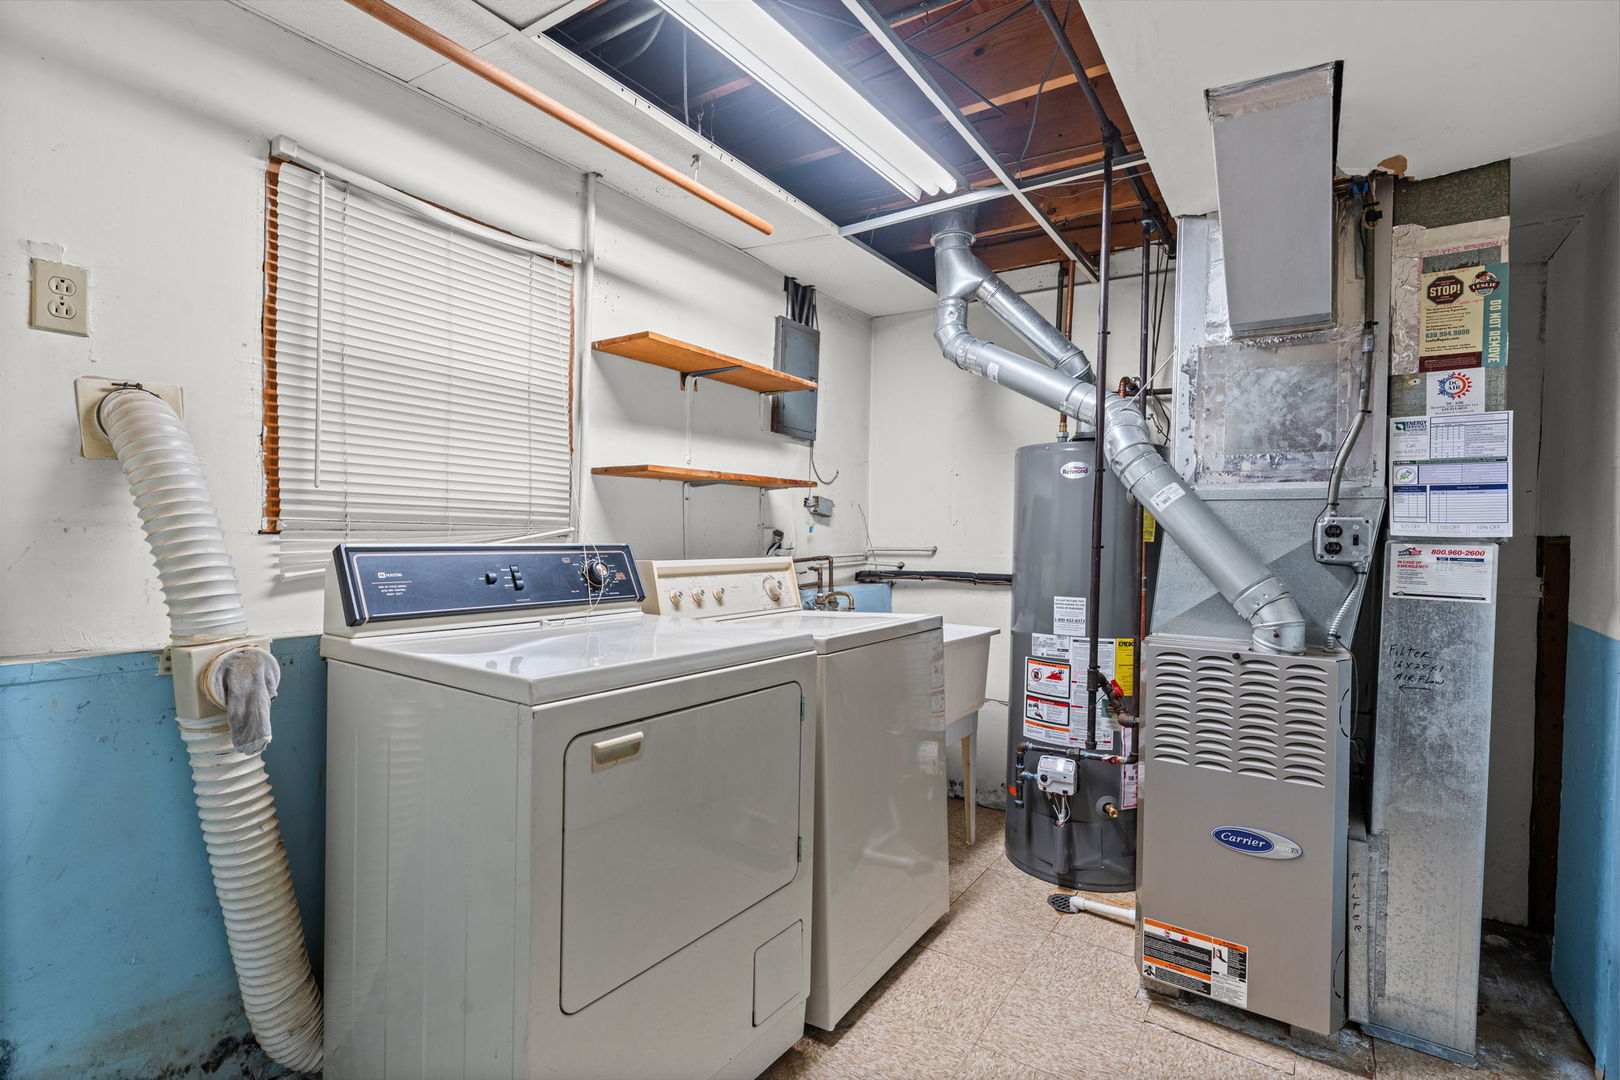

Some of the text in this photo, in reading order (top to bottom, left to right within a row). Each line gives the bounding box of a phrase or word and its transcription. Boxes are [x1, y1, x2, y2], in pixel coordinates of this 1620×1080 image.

[1429, 284, 1461, 297] STOP!
[1488, 299, 1502, 363] DO NOT REMOVE
[1062, 467, 1089, 475] Richmond
[1431, 549, 1485, 557] 800.960-2600
[1393, 673, 1415, 682] AIR
[1220, 831, 1266, 848] Carrier
